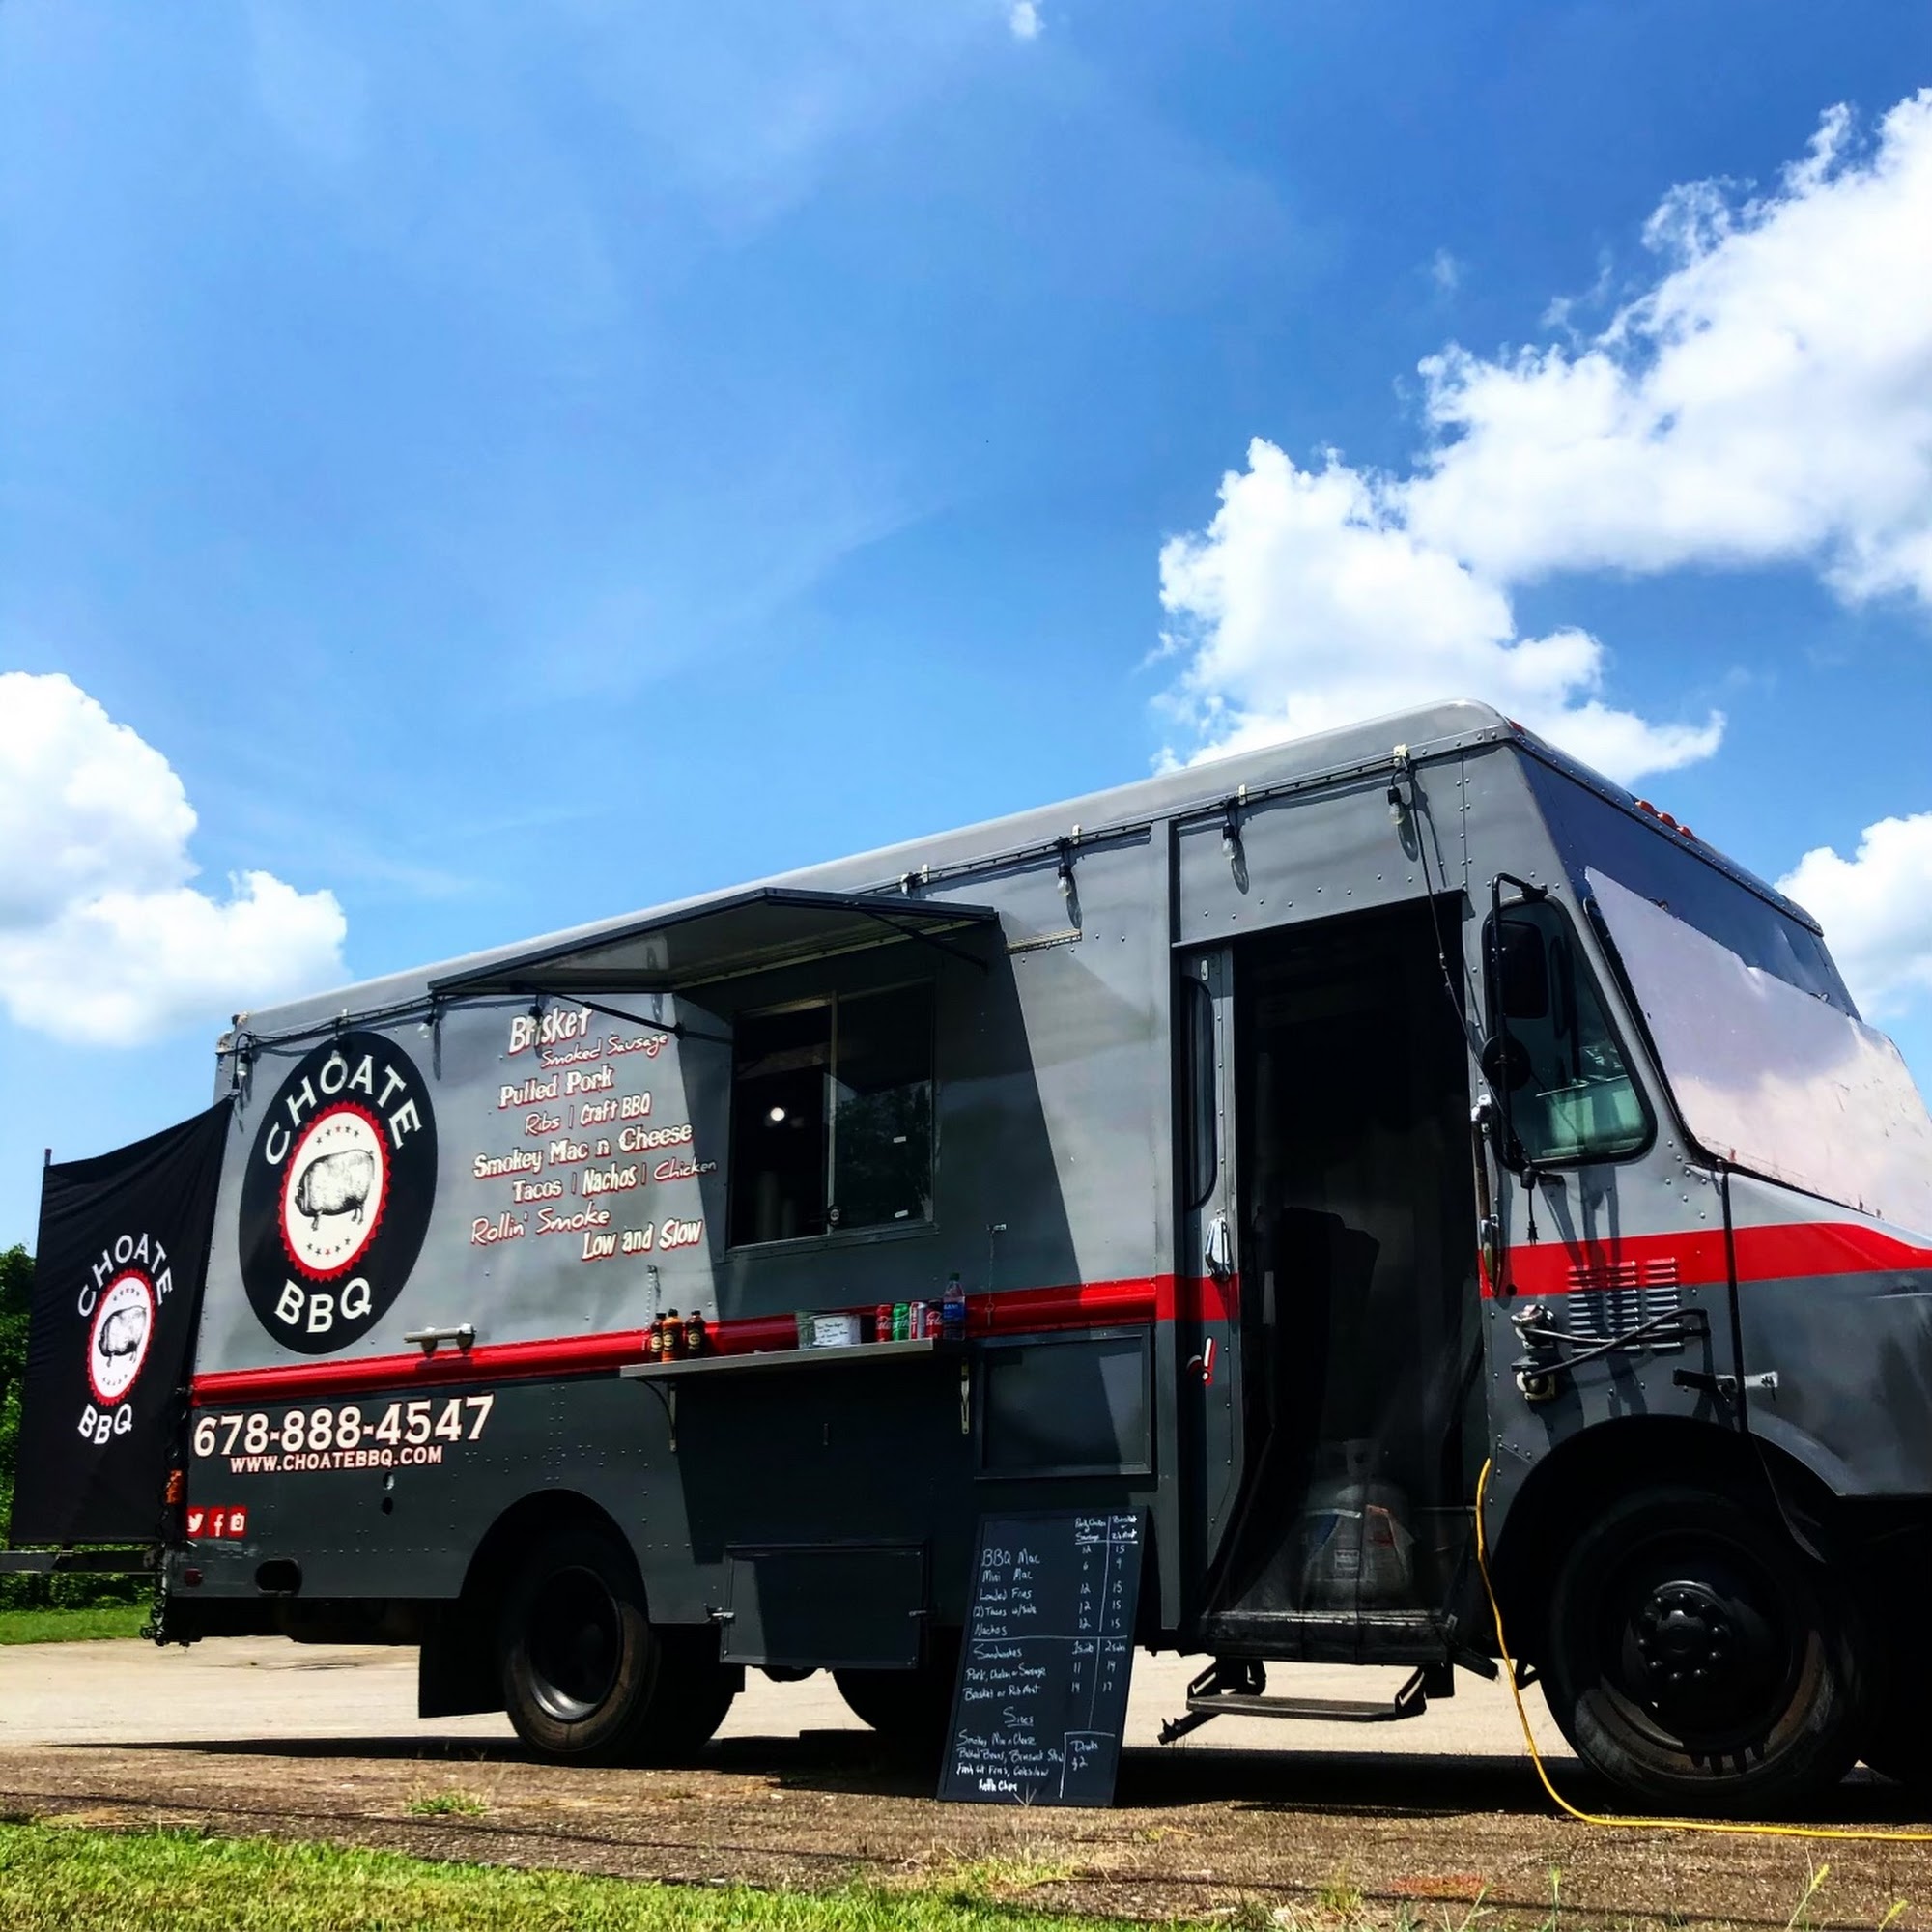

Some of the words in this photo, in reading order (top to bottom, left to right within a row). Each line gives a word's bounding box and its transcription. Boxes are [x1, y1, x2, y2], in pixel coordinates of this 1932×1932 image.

[508, 1006, 592, 1056] Brisket
[540, 1037, 602, 1068] Smoked
[607, 1031, 668, 1058] Sausage
[498, 1075, 558, 1108] Pulled
[564, 1065, 614, 1095] Pork
[265, 1054, 423, 1165] CHOATE
[525, 1113, 561, 1136] Ribs
[580, 1099, 619, 1127] Craft
[620, 1092, 652, 1120] BBQ
[472, 1148, 543, 1179] Smokey
[548, 1139, 589, 1165] Mac
[595, 1137, 611, 1157] n
[617, 1123, 694, 1153] Cheese
[513, 1179, 563, 1203] Tacos
[582, 1163, 637, 1196] Nachos
[653, 1159, 717, 1181] Chicken
[470, 1212, 528, 1245] Rollin'
[536, 1201, 611, 1236] Smoke
[581, 1231, 618, 1261] Low
[622, 1222, 653, 1254] and
[659, 1217, 703, 1251] Slow
[77, 1233, 173, 1318] CHOATE
[274, 1277, 372, 1334] BBQ
[77, 1403, 133, 1445] BBQ
[193, 1394, 495, 1457] 678-888-4547
[230, 1446, 443, 1473] WWW.CHOATEBBQ.COM
[981, 1548, 1011, 1567] BBQ
[1017, 1548, 1040, 1565] Mac
[1115, 1546, 1125, 1554] 15
[1013, 1568, 1033, 1581] Mac
[1113, 1581, 1122, 1594] 15
[1079, 1601, 1092, 1615] 12
[1111, 1619, 1121, 1629] 15
[1112, 1600, 1122, 1610] 15
[974, 1623, 1008, 1635] Nachos
